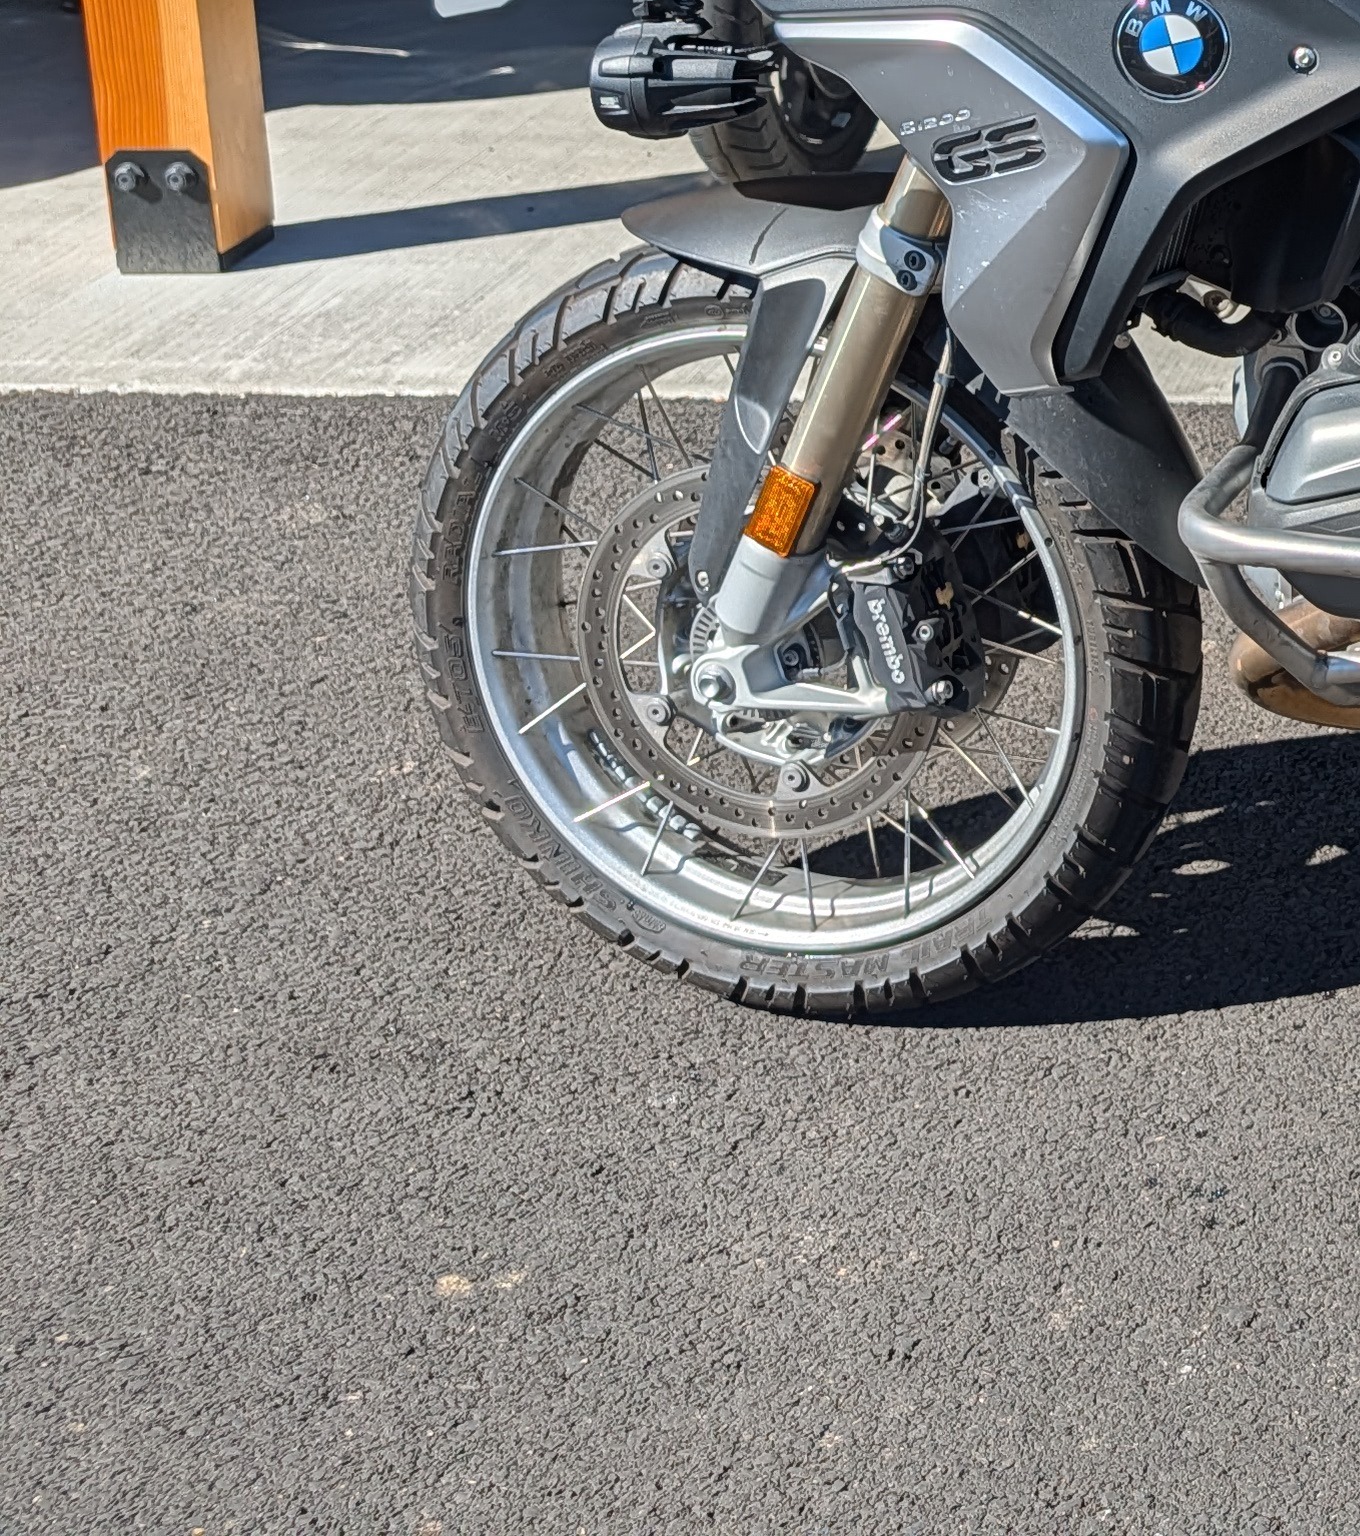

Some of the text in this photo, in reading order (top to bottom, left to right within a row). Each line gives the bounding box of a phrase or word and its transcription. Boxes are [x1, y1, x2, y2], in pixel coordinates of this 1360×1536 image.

[931, 116, 1046, 184] GS
[867, 598, 905, 684] brembo
[503, 794, 621, 914] SHINKO
[737, 906, 993, 979] TRAIL MASTER
